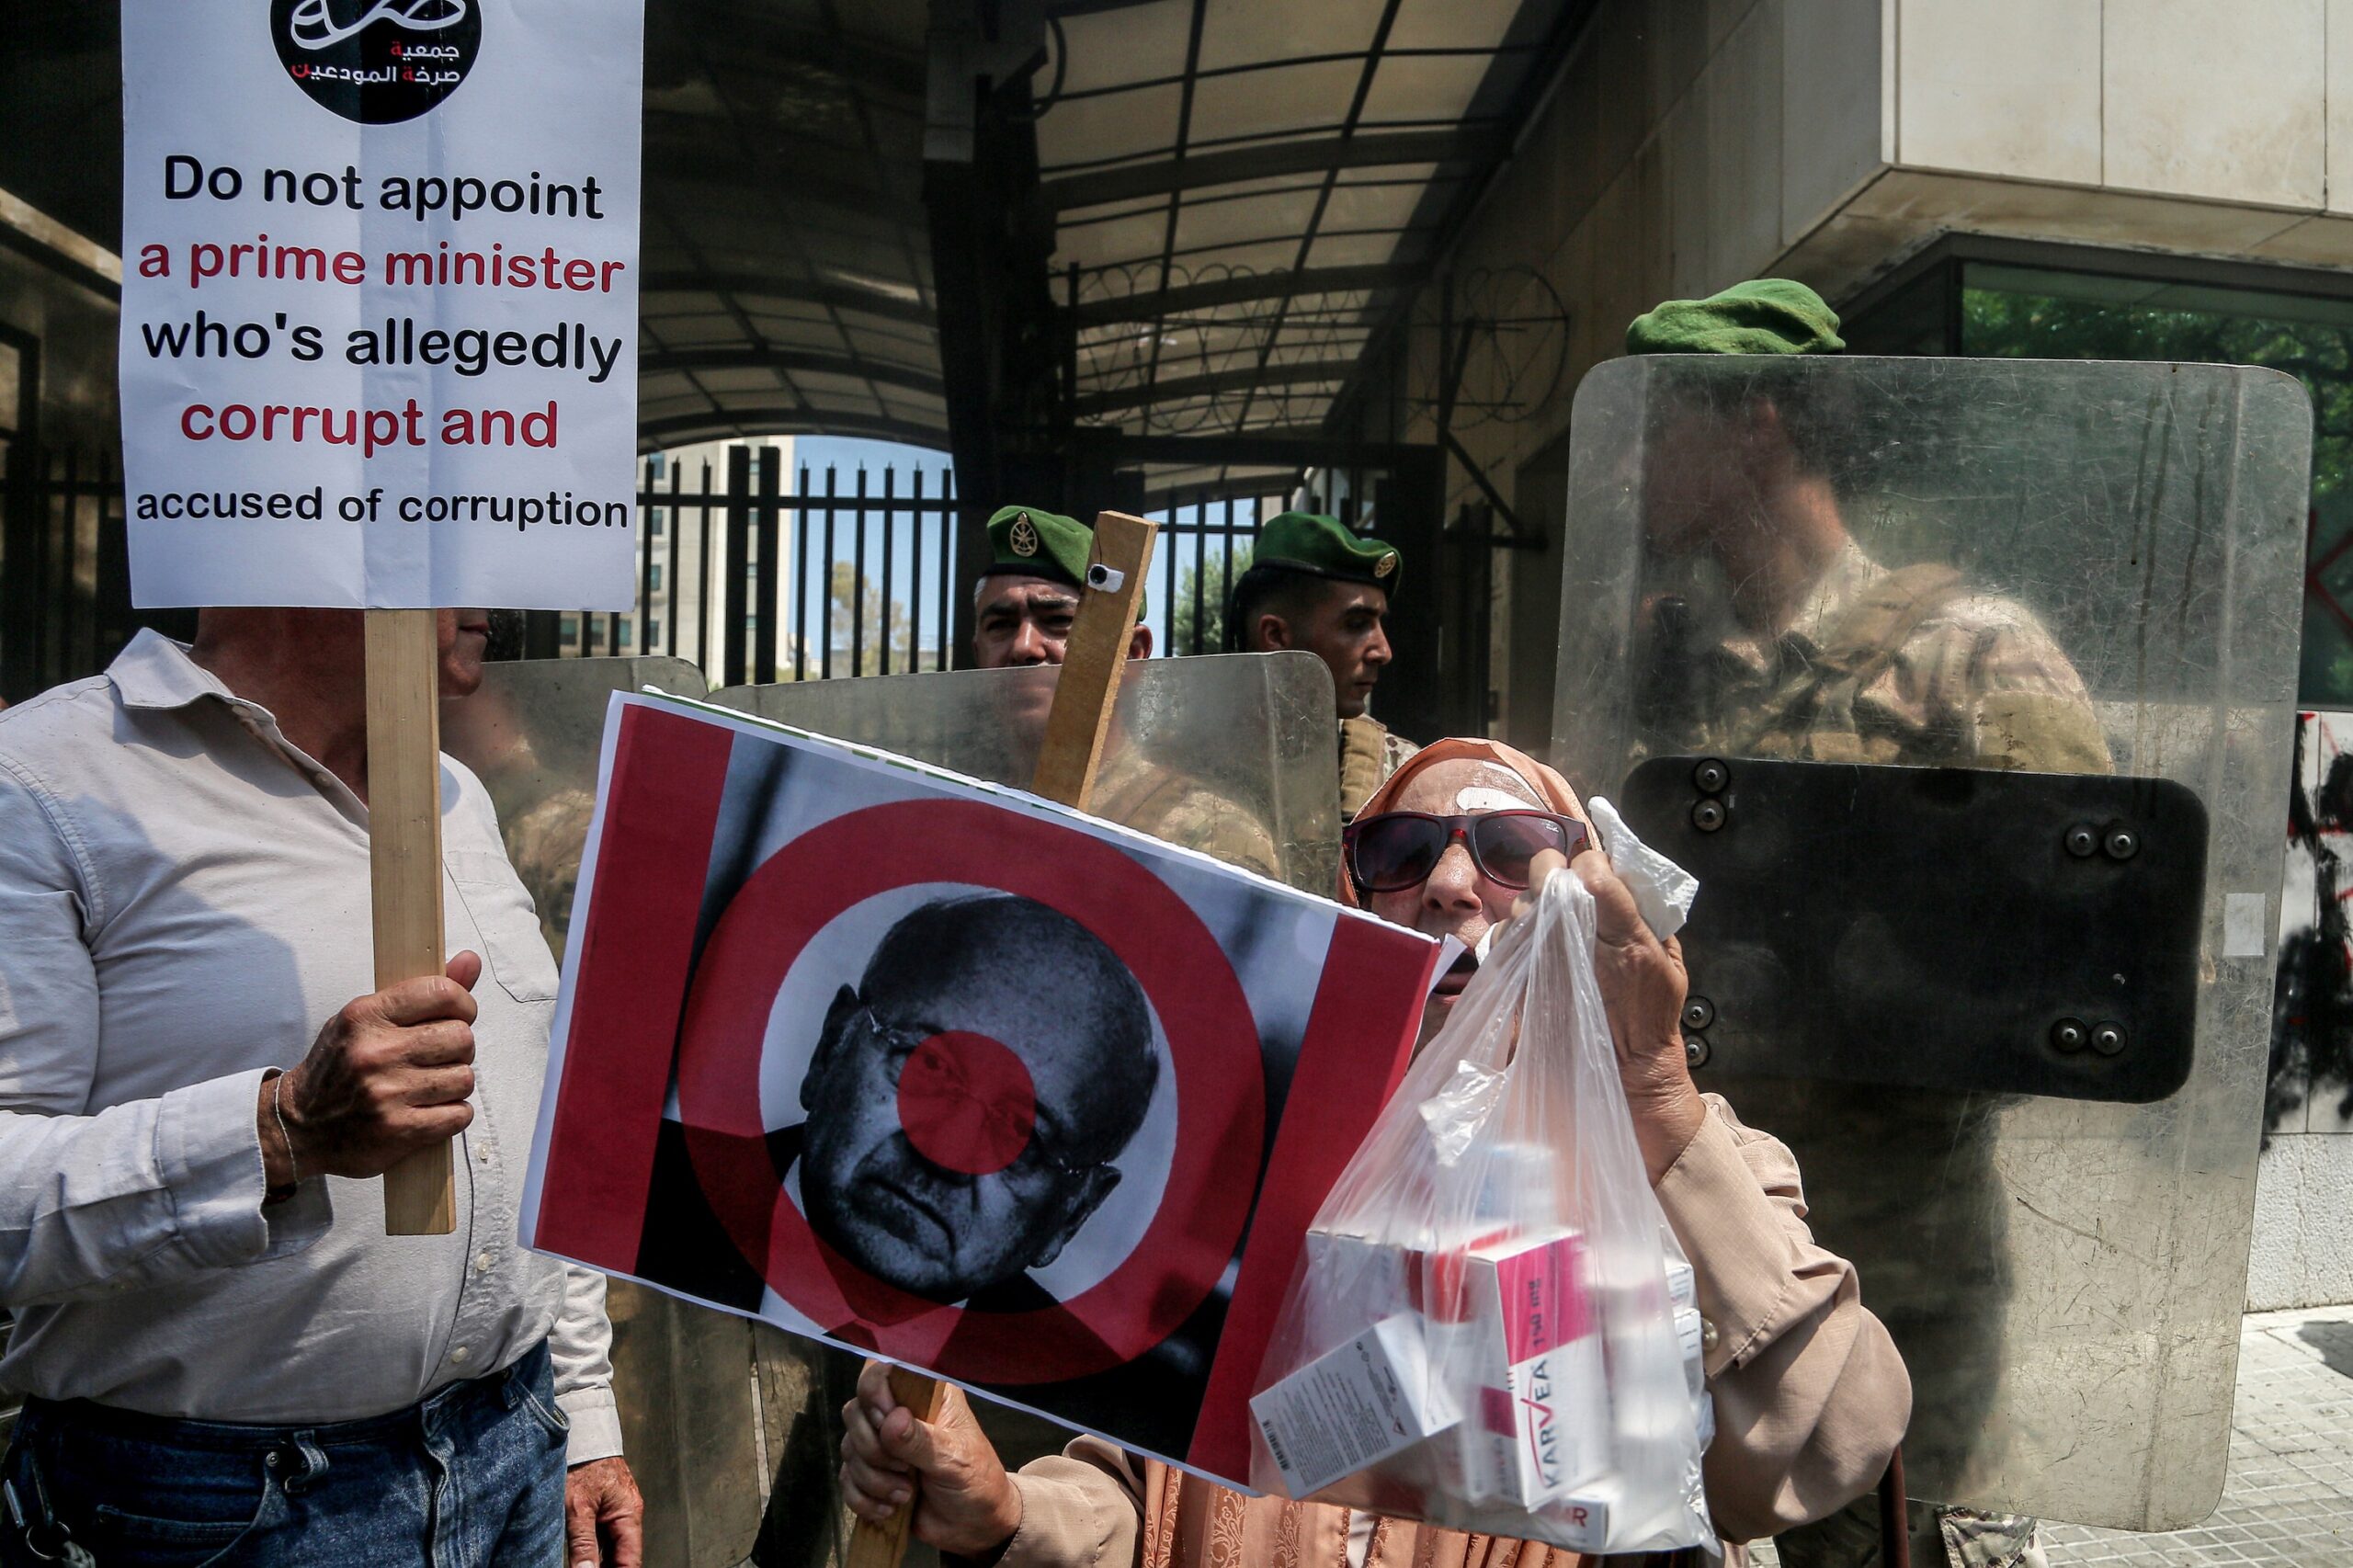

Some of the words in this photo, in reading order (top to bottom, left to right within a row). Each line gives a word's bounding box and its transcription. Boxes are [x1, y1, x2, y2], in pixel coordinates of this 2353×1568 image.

[290, 62, 397, 85] المودعين
[391, 40, 460, 62] جمعية
[402, 66, 460, 85] صرخة
[165, 154, 243, 200] Do
[264, 165, 365, 210] not
[379, 171, 605, 222] appoint
[139, 244, 171, 278] a
[190, 233, 366, 290] prime
[385, 241, 625, 293] minister
[141, 310, 324, 361] who's
[346, 317, 622, 383] allegedly
[180, 398, 426, 460] corrupt
[440, 400, 558, 449] and
[136, 485, 323, 520] accused
[338, 488, 384, 523] of
[398, 491, 628, 532] corruption
[1522, 1359, 1560, 1489] KARVEA
